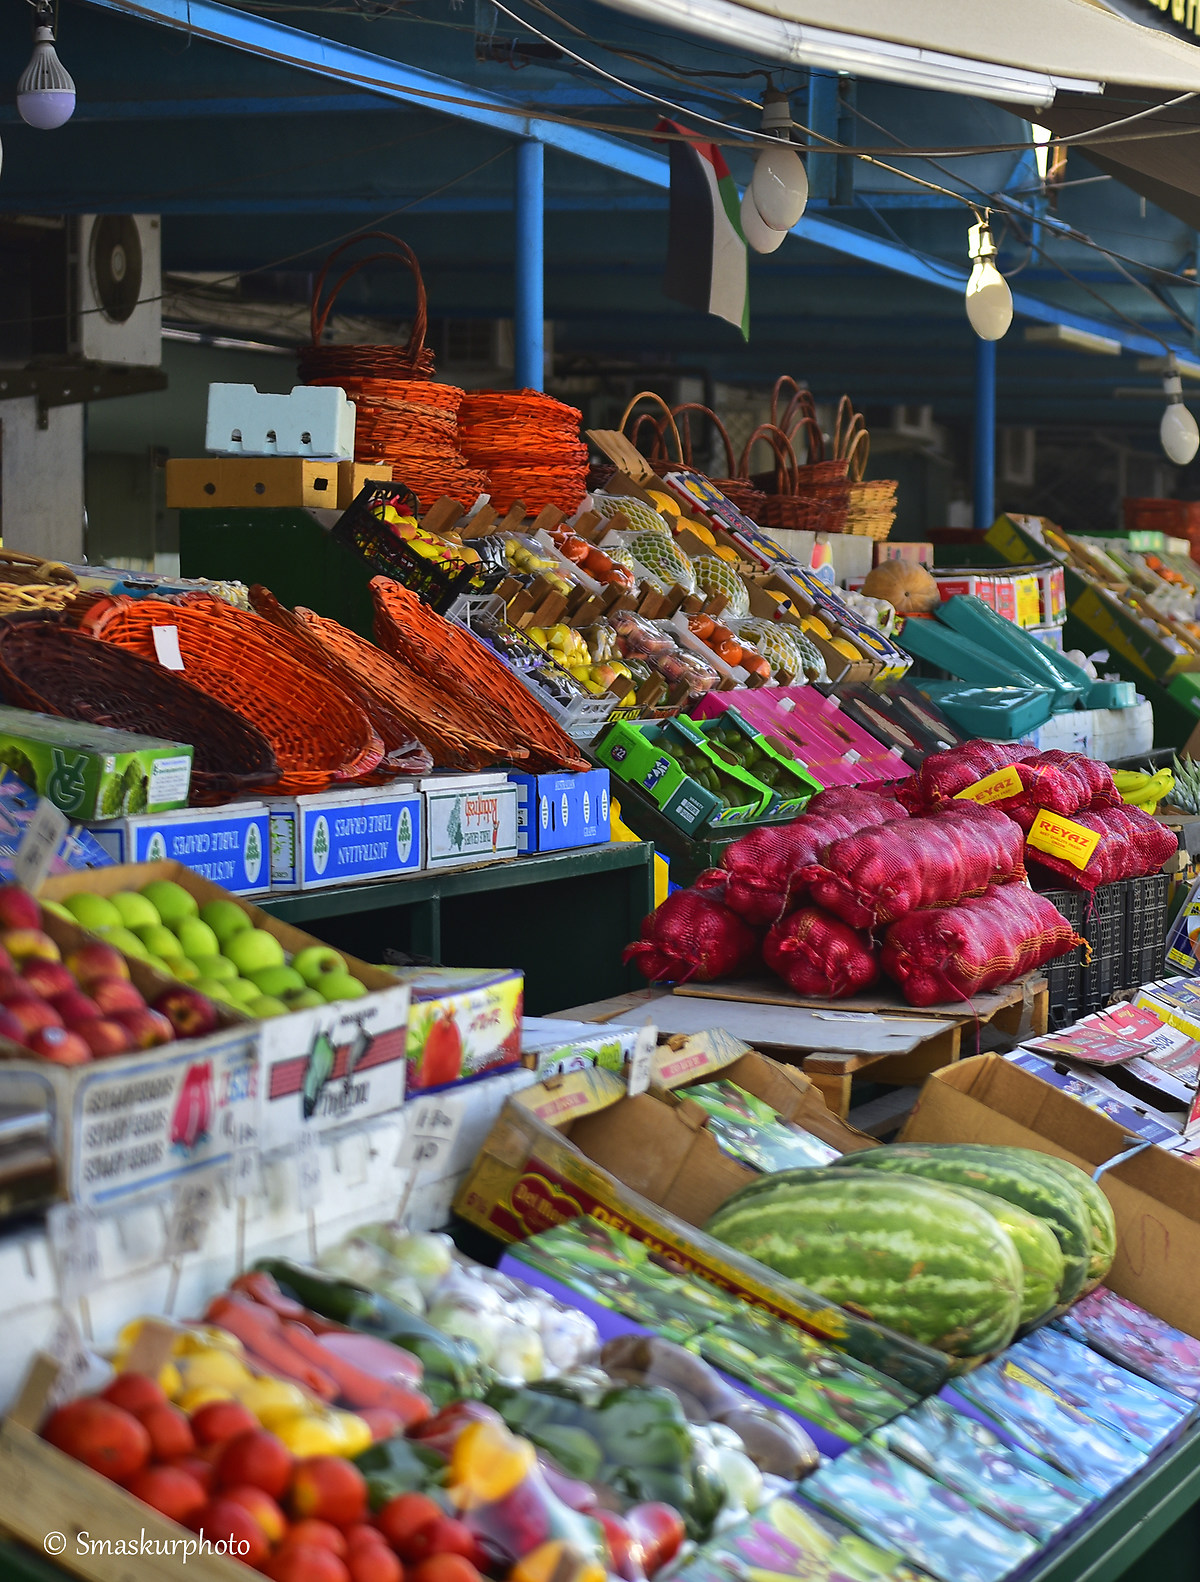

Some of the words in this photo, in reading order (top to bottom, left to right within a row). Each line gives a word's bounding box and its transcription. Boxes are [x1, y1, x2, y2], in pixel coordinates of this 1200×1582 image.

[970, 778, 1014, 801] EYAZ
[334, 816, 367, 837] GRAPES
[368, 814, 393, 833] TABLE
[1039, 820, 1090, 847] REYAZ
[173, 833, 211, 856] GRAPES
[212, 830, 240, 851] TABLE
[338, 842, 389, 865] AUSTRALIAN
